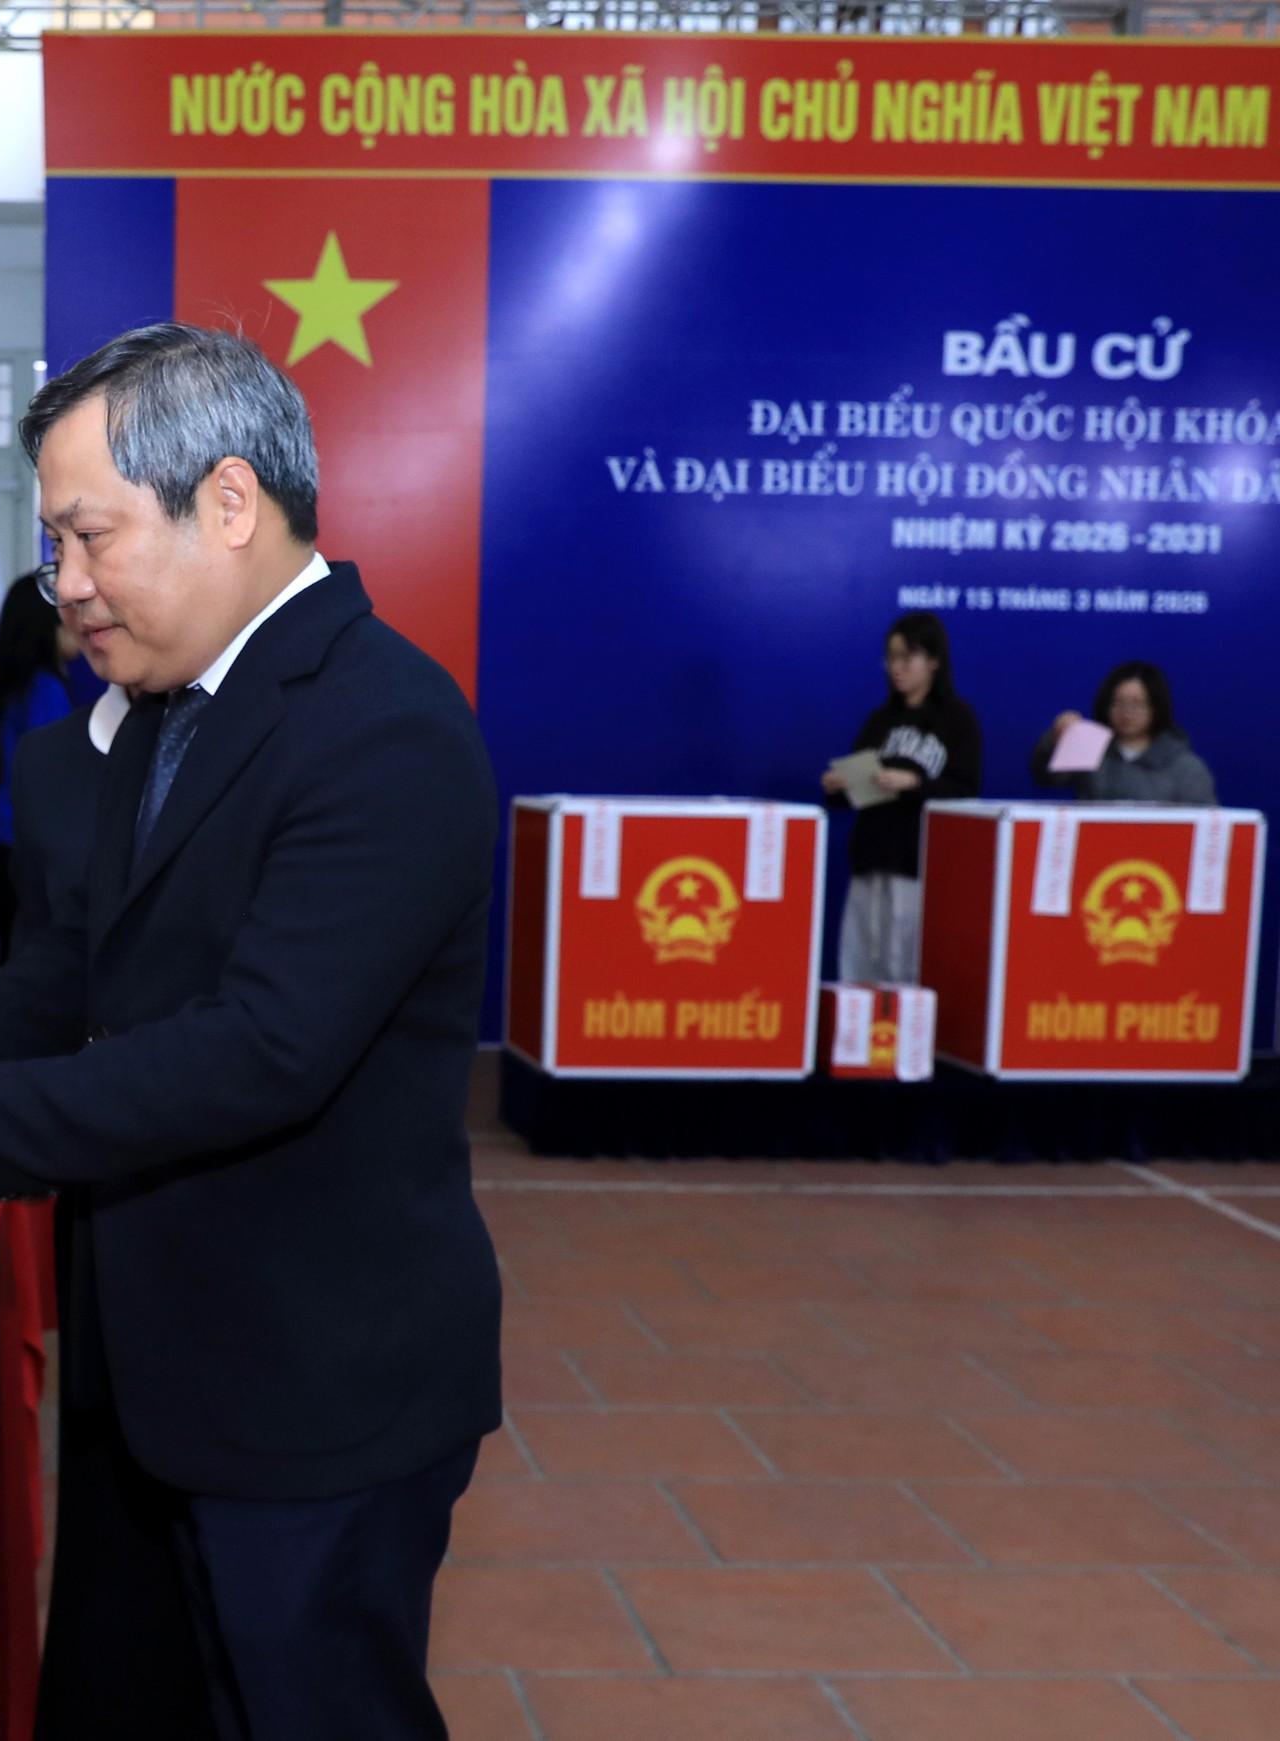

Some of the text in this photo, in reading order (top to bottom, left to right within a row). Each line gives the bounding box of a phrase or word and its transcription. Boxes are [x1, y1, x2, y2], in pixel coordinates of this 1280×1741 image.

[170, 58, 1271, 160] NƯỚC CỘNG HÒA XÃ HỘI CHỦ NGHĨA VIỆT NAM
[942, 313, 1192, 381] BẦU CỬ
[749, 399, 825, 445] ĐẠI
[836, 383, 942, 438] BIỂU
[950, 390, 1074, 447] QUỐC
[1084, 396, 1163, 451] HỘI
[605, 446, 665, 493] VÀ
[673, 457, 751, 502] ĐẠI
[761, 442, 867, 496] BIỂU
[876, 451, 955, 507] HỘI
[966, 448, 1088, 500] ĐỒNG
[1099, 455, 1221, 503] NHÂN
[891, 512, 997, 556] NHIỆM
[1002, 513, 1047, 551] KỲ
[583, 992, 665, 1039] HÒM
[675, 987, 782, 1041] PHIẾU
[1027, 990, 1220, 1042] HÒM PHIẾU
